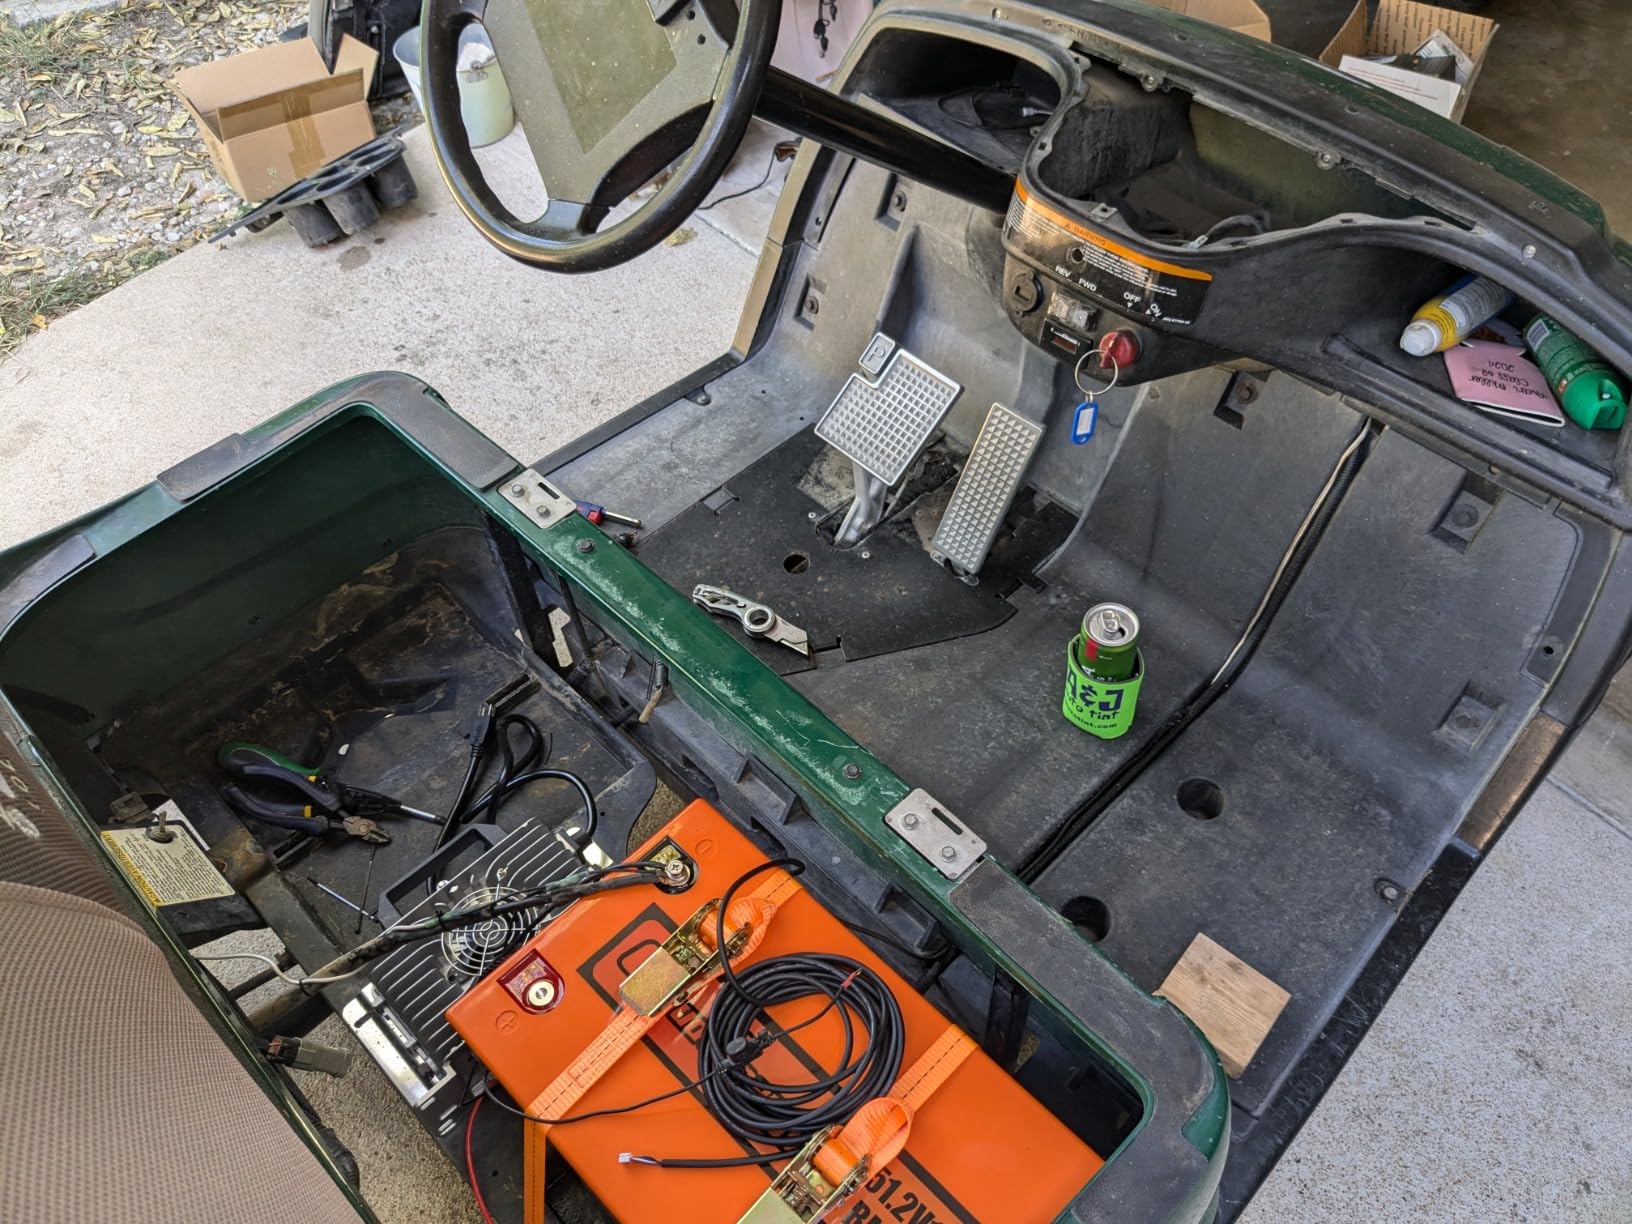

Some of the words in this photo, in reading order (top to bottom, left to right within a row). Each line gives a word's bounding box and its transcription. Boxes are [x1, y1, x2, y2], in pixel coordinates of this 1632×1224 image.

[1074, 227, 1106, 246] WARNING
[1055, 265, 1072, 278] REV
[1078, 278, 1097, 292] FWD
[1123, 291, 1141, 303] OFF
[1150, 303, 1162, 317] ON
[868, 346, 886, 362] P
[864, 1166, 945, 1224] 51.2V
